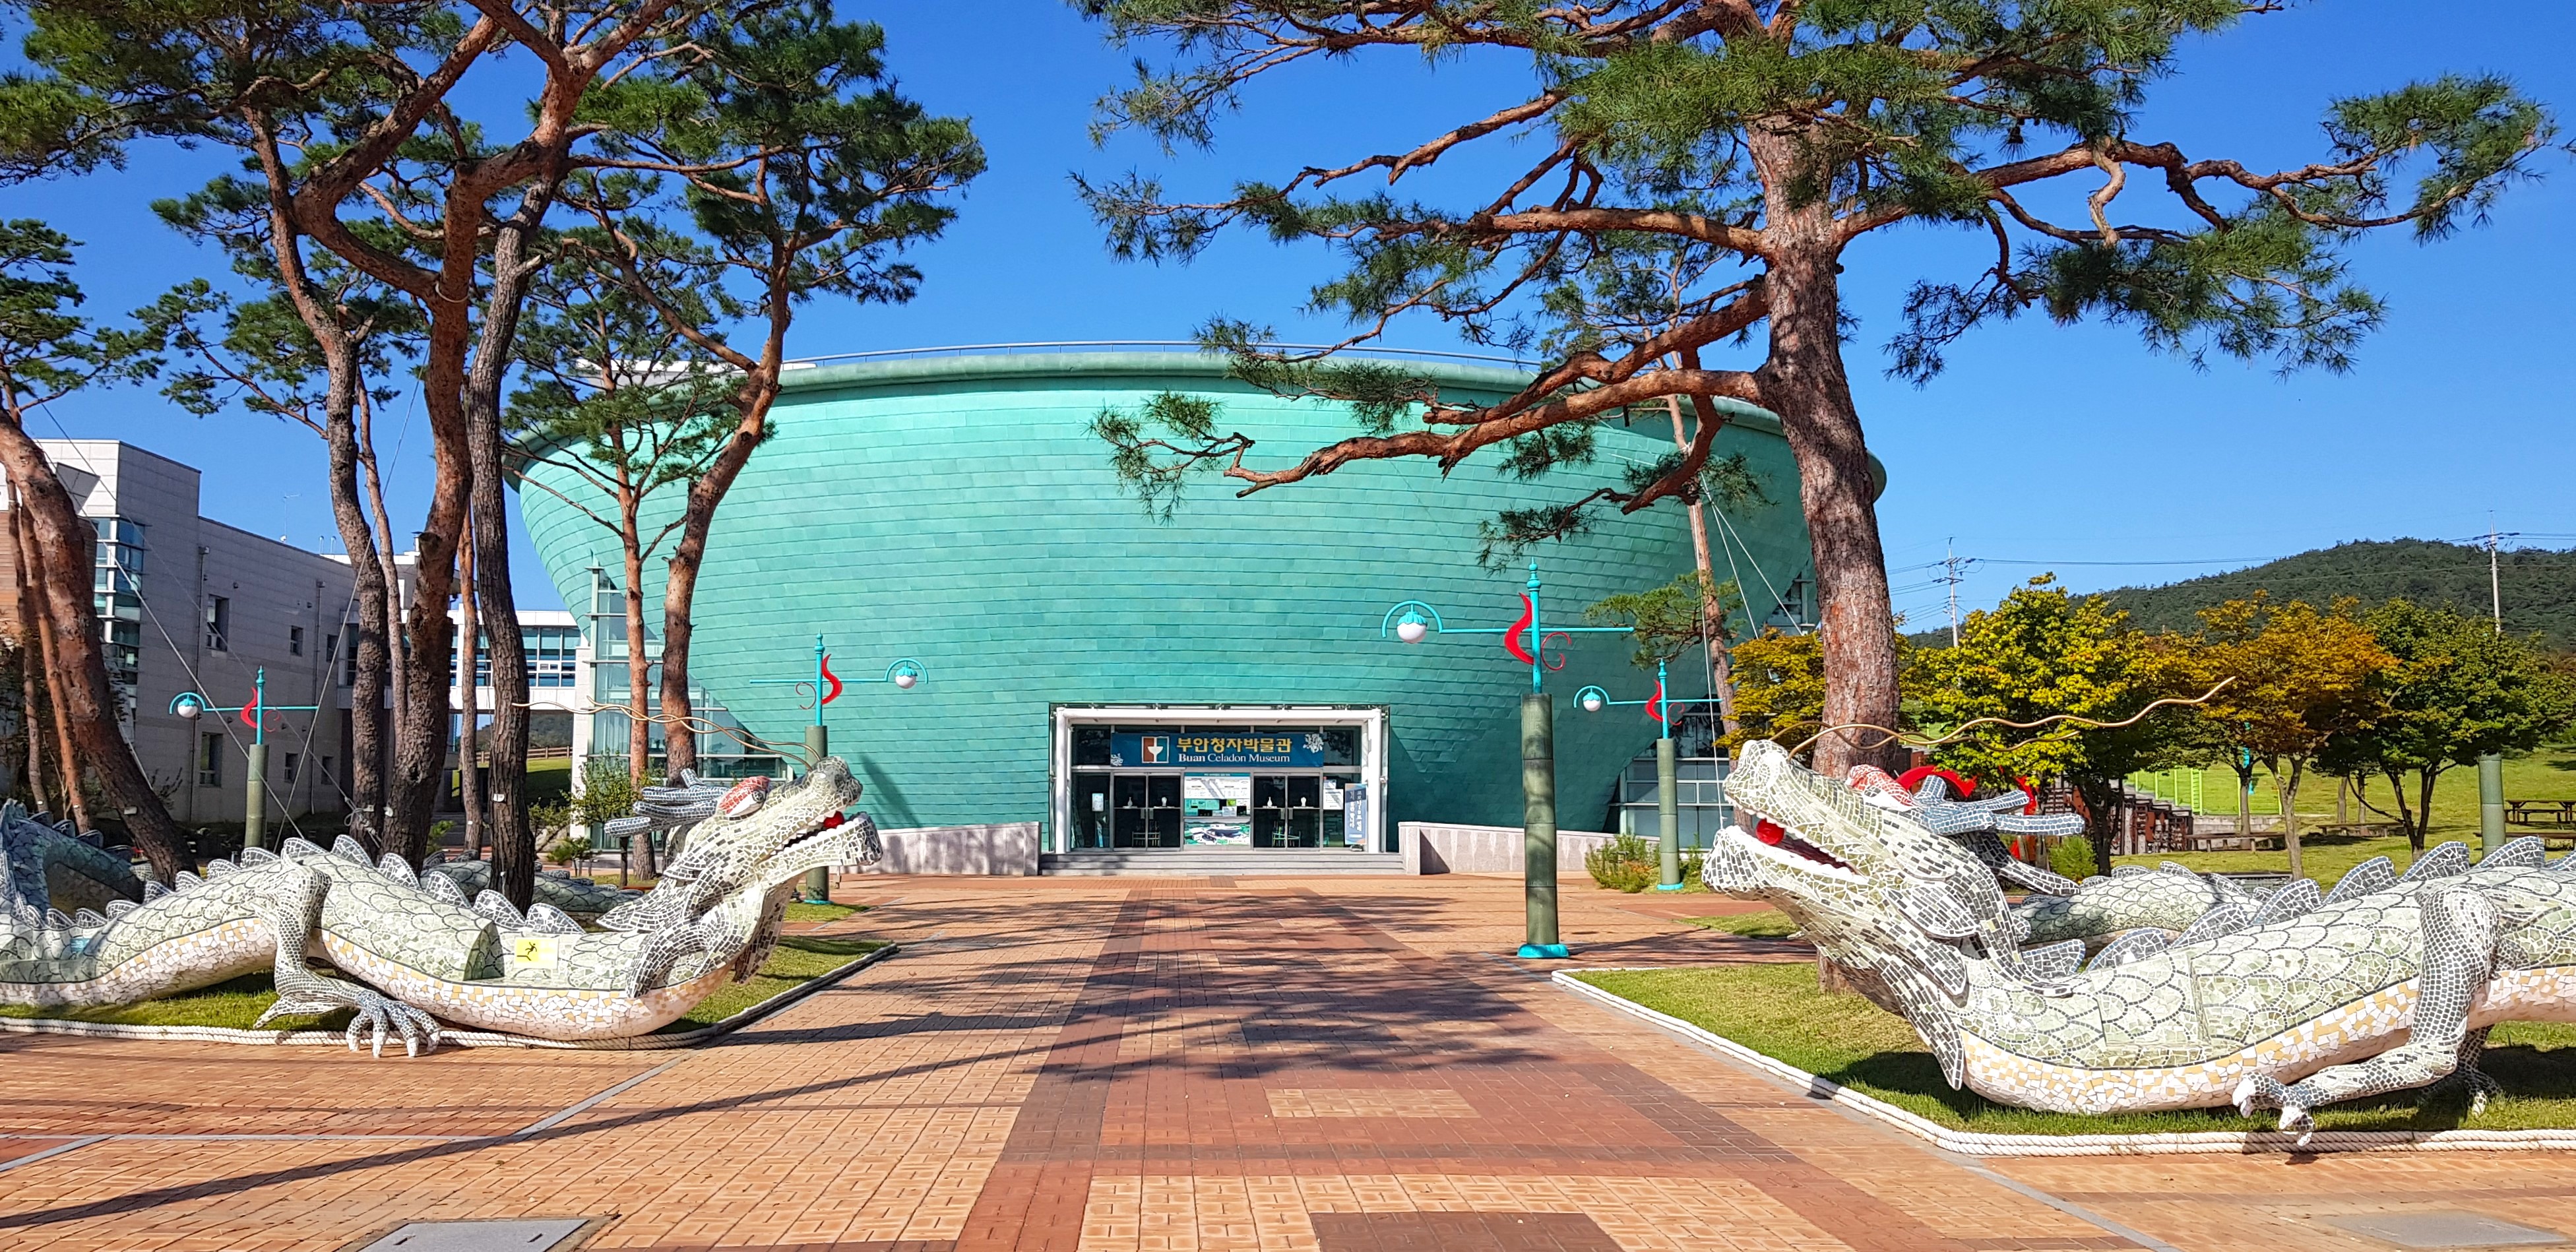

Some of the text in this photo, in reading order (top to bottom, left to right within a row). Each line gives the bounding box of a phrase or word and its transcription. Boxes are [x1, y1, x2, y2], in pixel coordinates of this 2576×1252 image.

[1177, 737, 1292, 753] 부안청자박물관
[1178, 753, 1290, 762] Buan Celadon Museum
